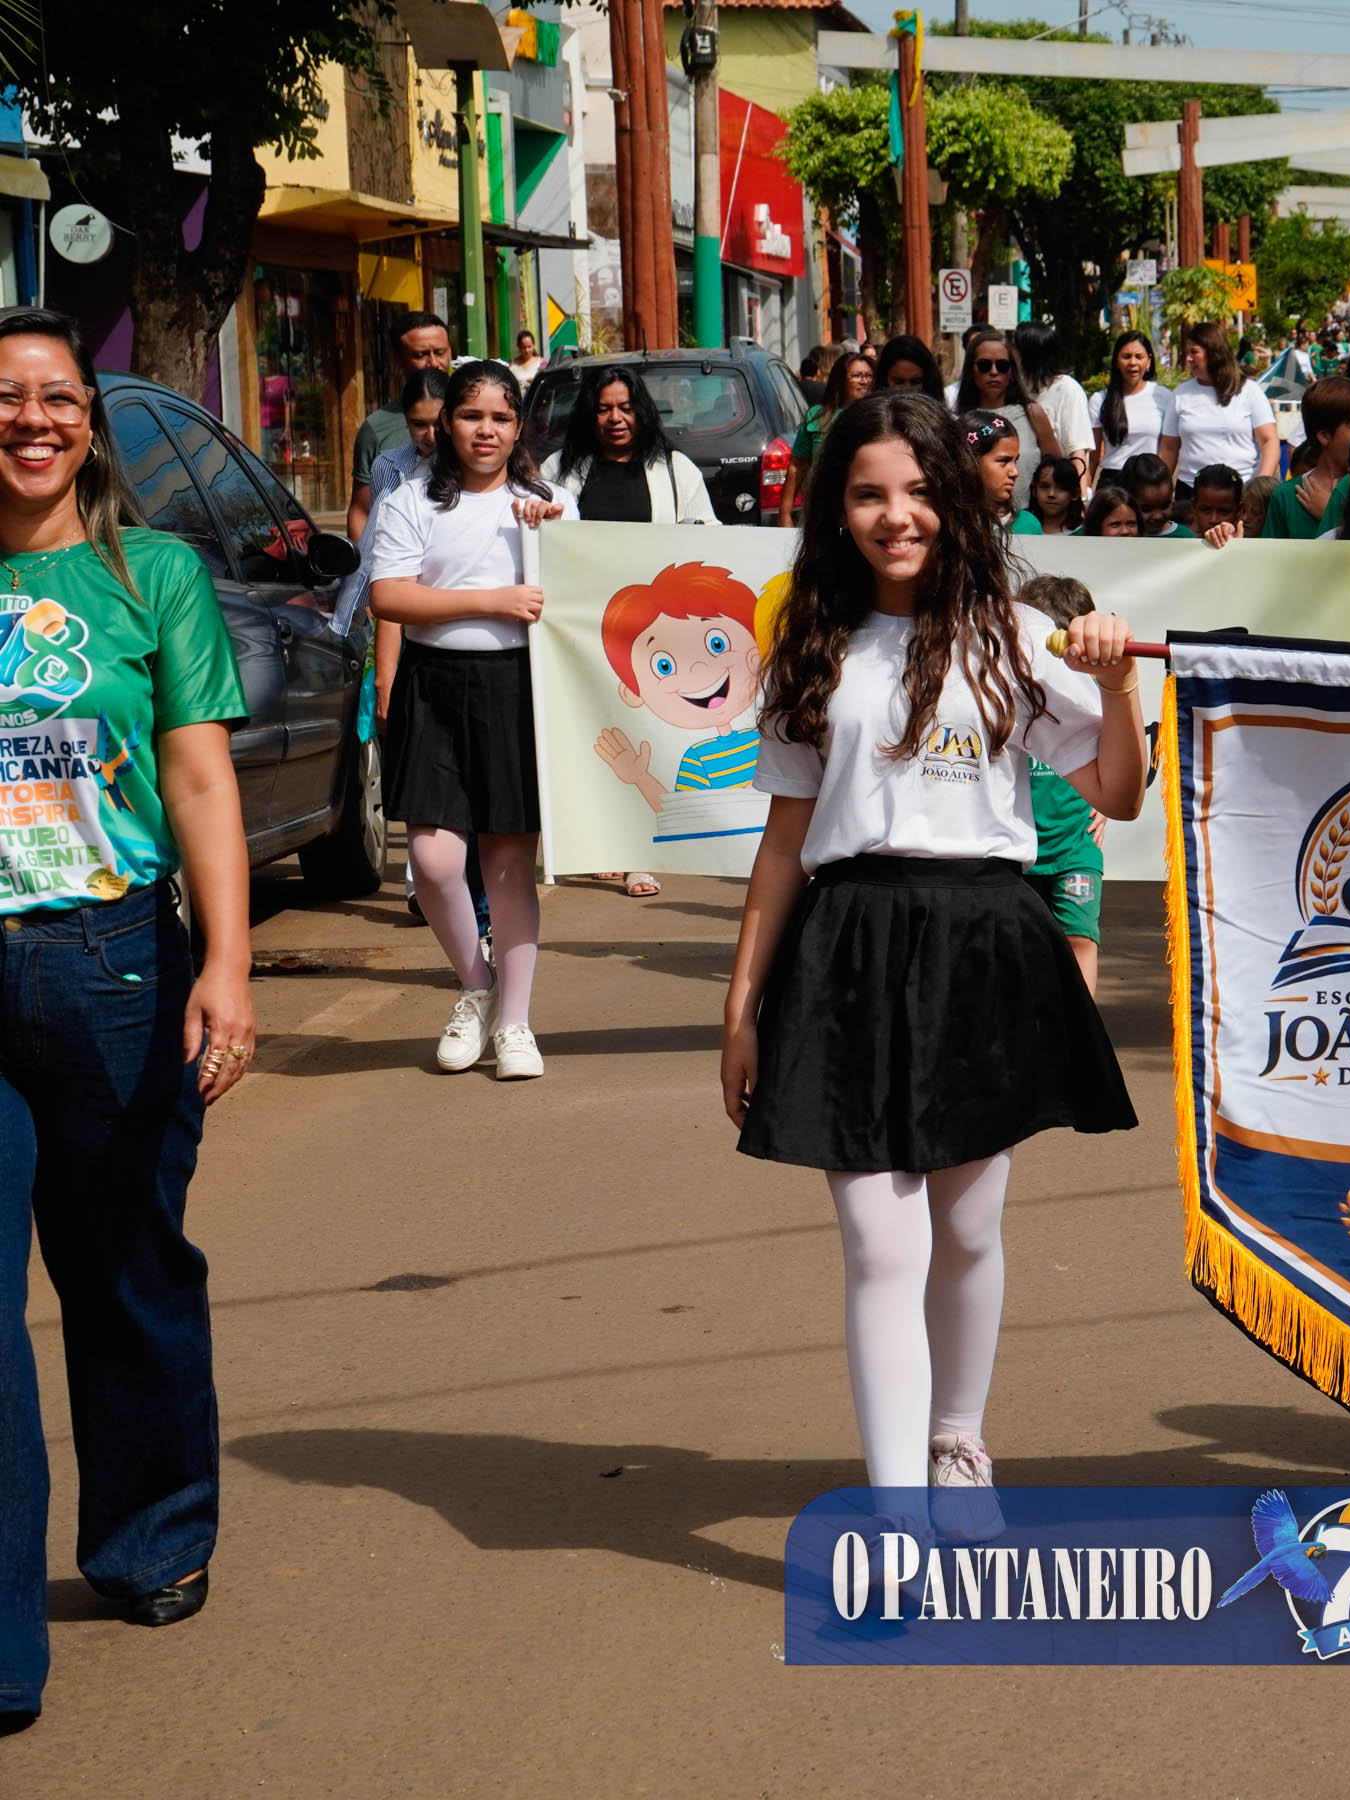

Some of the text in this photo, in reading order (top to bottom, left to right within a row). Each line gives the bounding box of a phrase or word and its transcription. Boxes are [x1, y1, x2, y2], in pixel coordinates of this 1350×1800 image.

[64, 233, 96, 241] BERRY
[950, 278, 961, 296] E
[998, 292, 1009, 306] E
[720, 456, 758, 464] TUCSON
[60, 740, 88, 757] QUE
[921, 765, 949, 778] JOÃO
[949, 769, 980, 782] ALVES
[17, 851, 26, 867] A
[25, 845, 103, 868] GENTE
